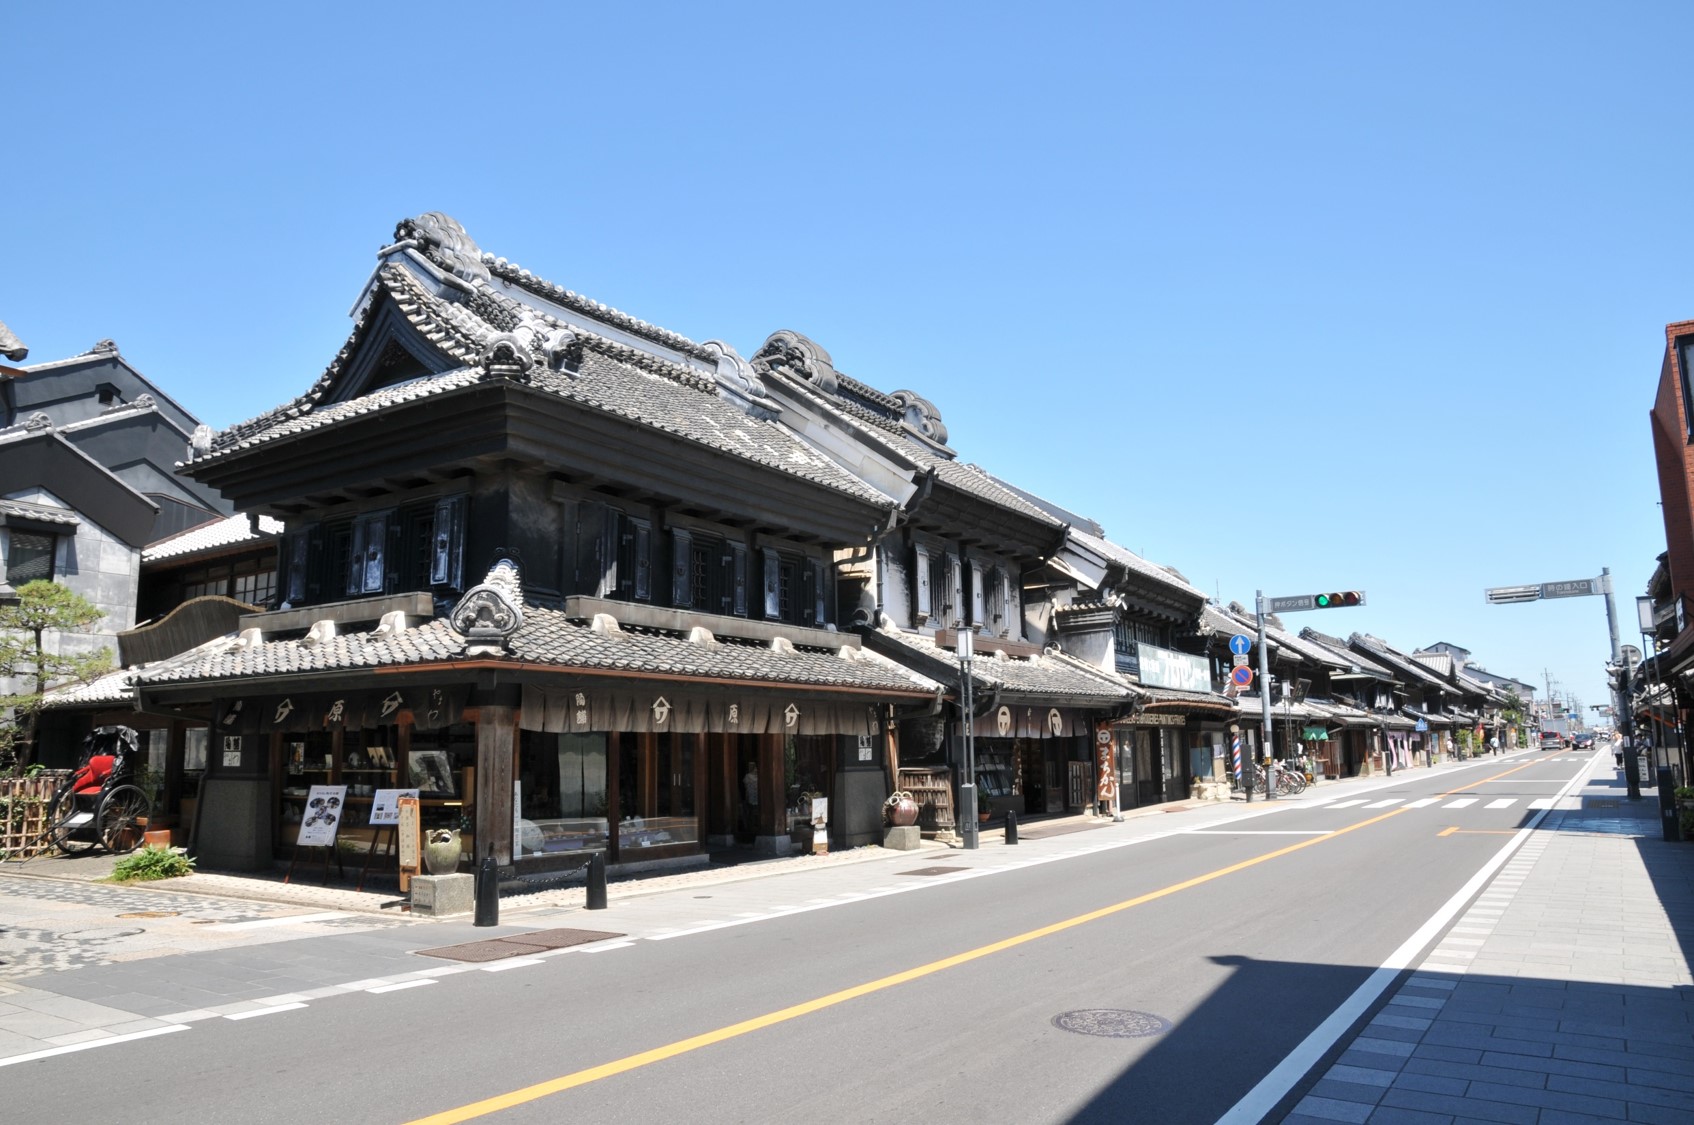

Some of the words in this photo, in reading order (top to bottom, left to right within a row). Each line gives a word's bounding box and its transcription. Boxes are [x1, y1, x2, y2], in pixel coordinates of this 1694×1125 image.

[328, 700, 345, 721] 原
[728, 704, 739, 724] 原
[1100, 746, 1115, 798] まちかん
